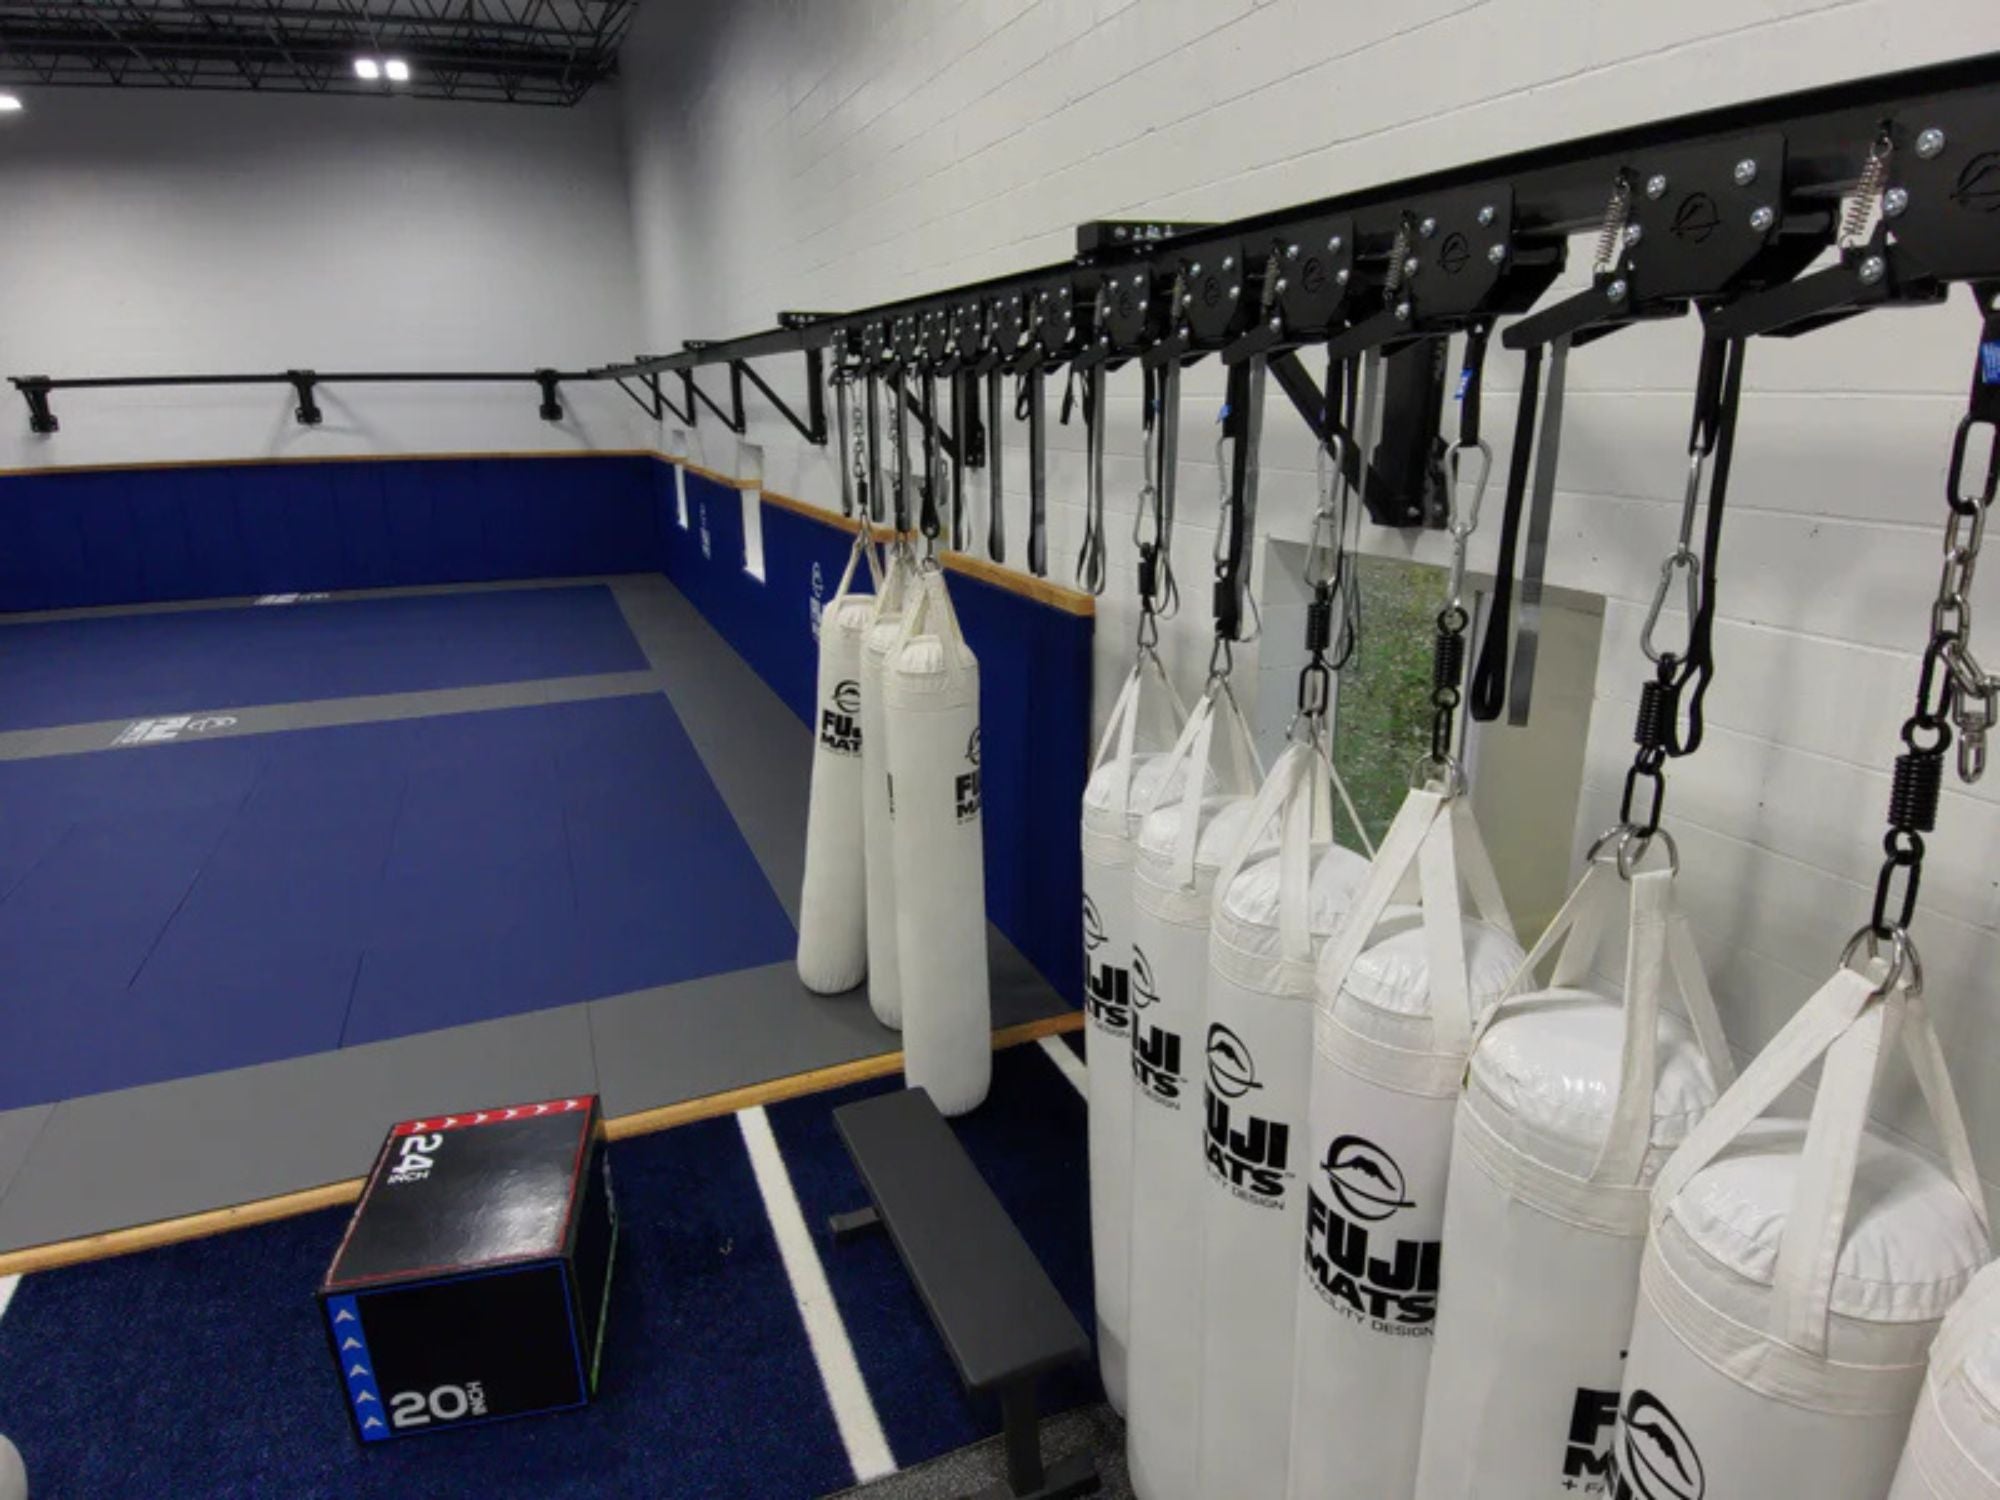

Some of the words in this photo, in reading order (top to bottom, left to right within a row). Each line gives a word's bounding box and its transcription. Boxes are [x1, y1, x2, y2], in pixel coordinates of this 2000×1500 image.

[821, 731, 862, 752] MAT
[822, 709, 861, 738] FU
[1087, 953, 1128, 1006] JI
[1087, 994, 1129, 1028] TS
[1132, 1008, 1181, 1076] JI
[1132, 1051, 1180, 1099] TS
[1203, 1083, 1289, 1170] UJI
[392, 1132, 444, 1173] 24
[1203, 1129, 1285, 1198] ATS
[1307, 1183, 1441, 1293] FUJI
[1305, 1234, 1437, 1323] MATS
[1371, 1319, 1434, 1338] DESIGN
[390, 1385, 468, 1428] 20
